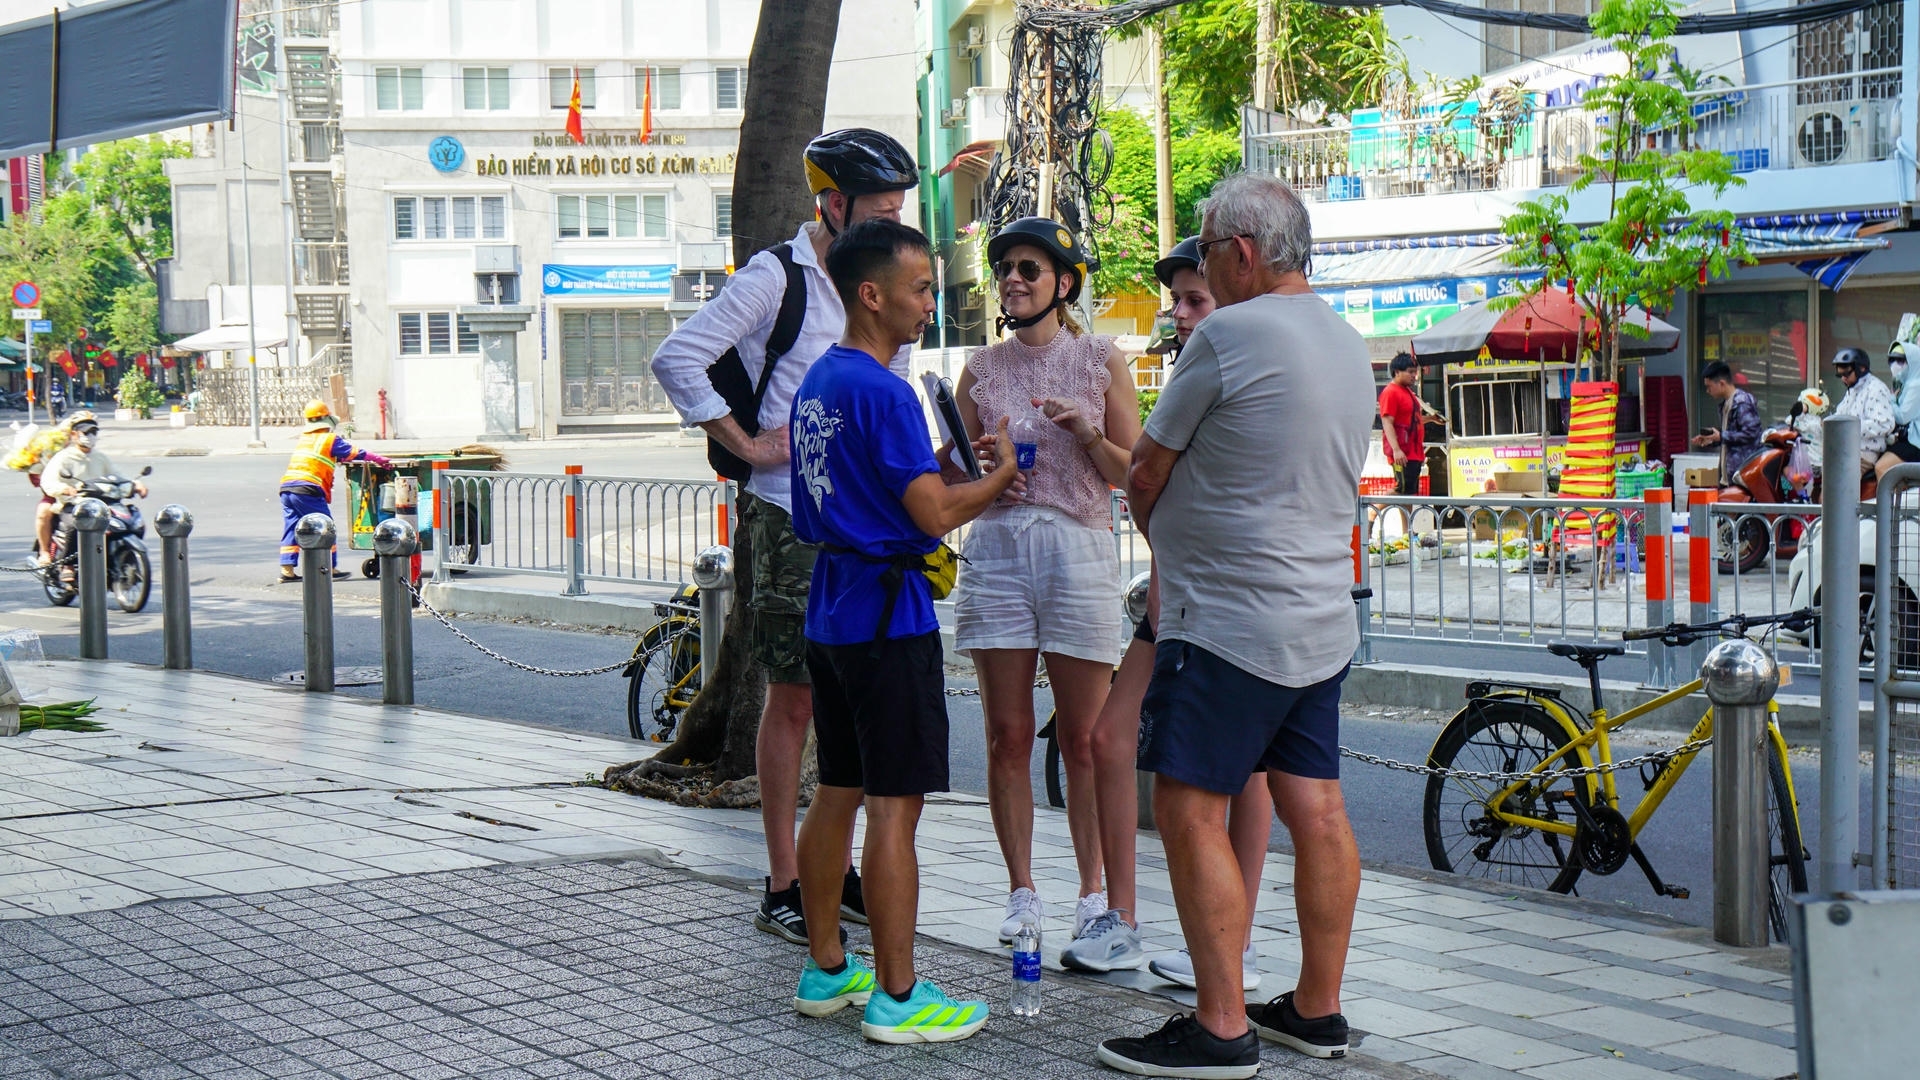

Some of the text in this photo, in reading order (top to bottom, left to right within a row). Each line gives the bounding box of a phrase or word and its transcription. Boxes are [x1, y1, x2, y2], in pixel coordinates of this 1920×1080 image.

[533, 131, 552, 147] BẢO
[595, 131, 611, 149] HỘI
[476, 153, 507, 177] BẢO
[512, 151, 550, 177] HIỂM
[555, 153, 576, 176] XÃ
[580, 153, 606, 178] HỘI
[611, 155, 631, 175] CƠ
[1381, 281, 1447, 305] NHÀ THUỐC
[1397, 309, 1418, 332] SỐ
